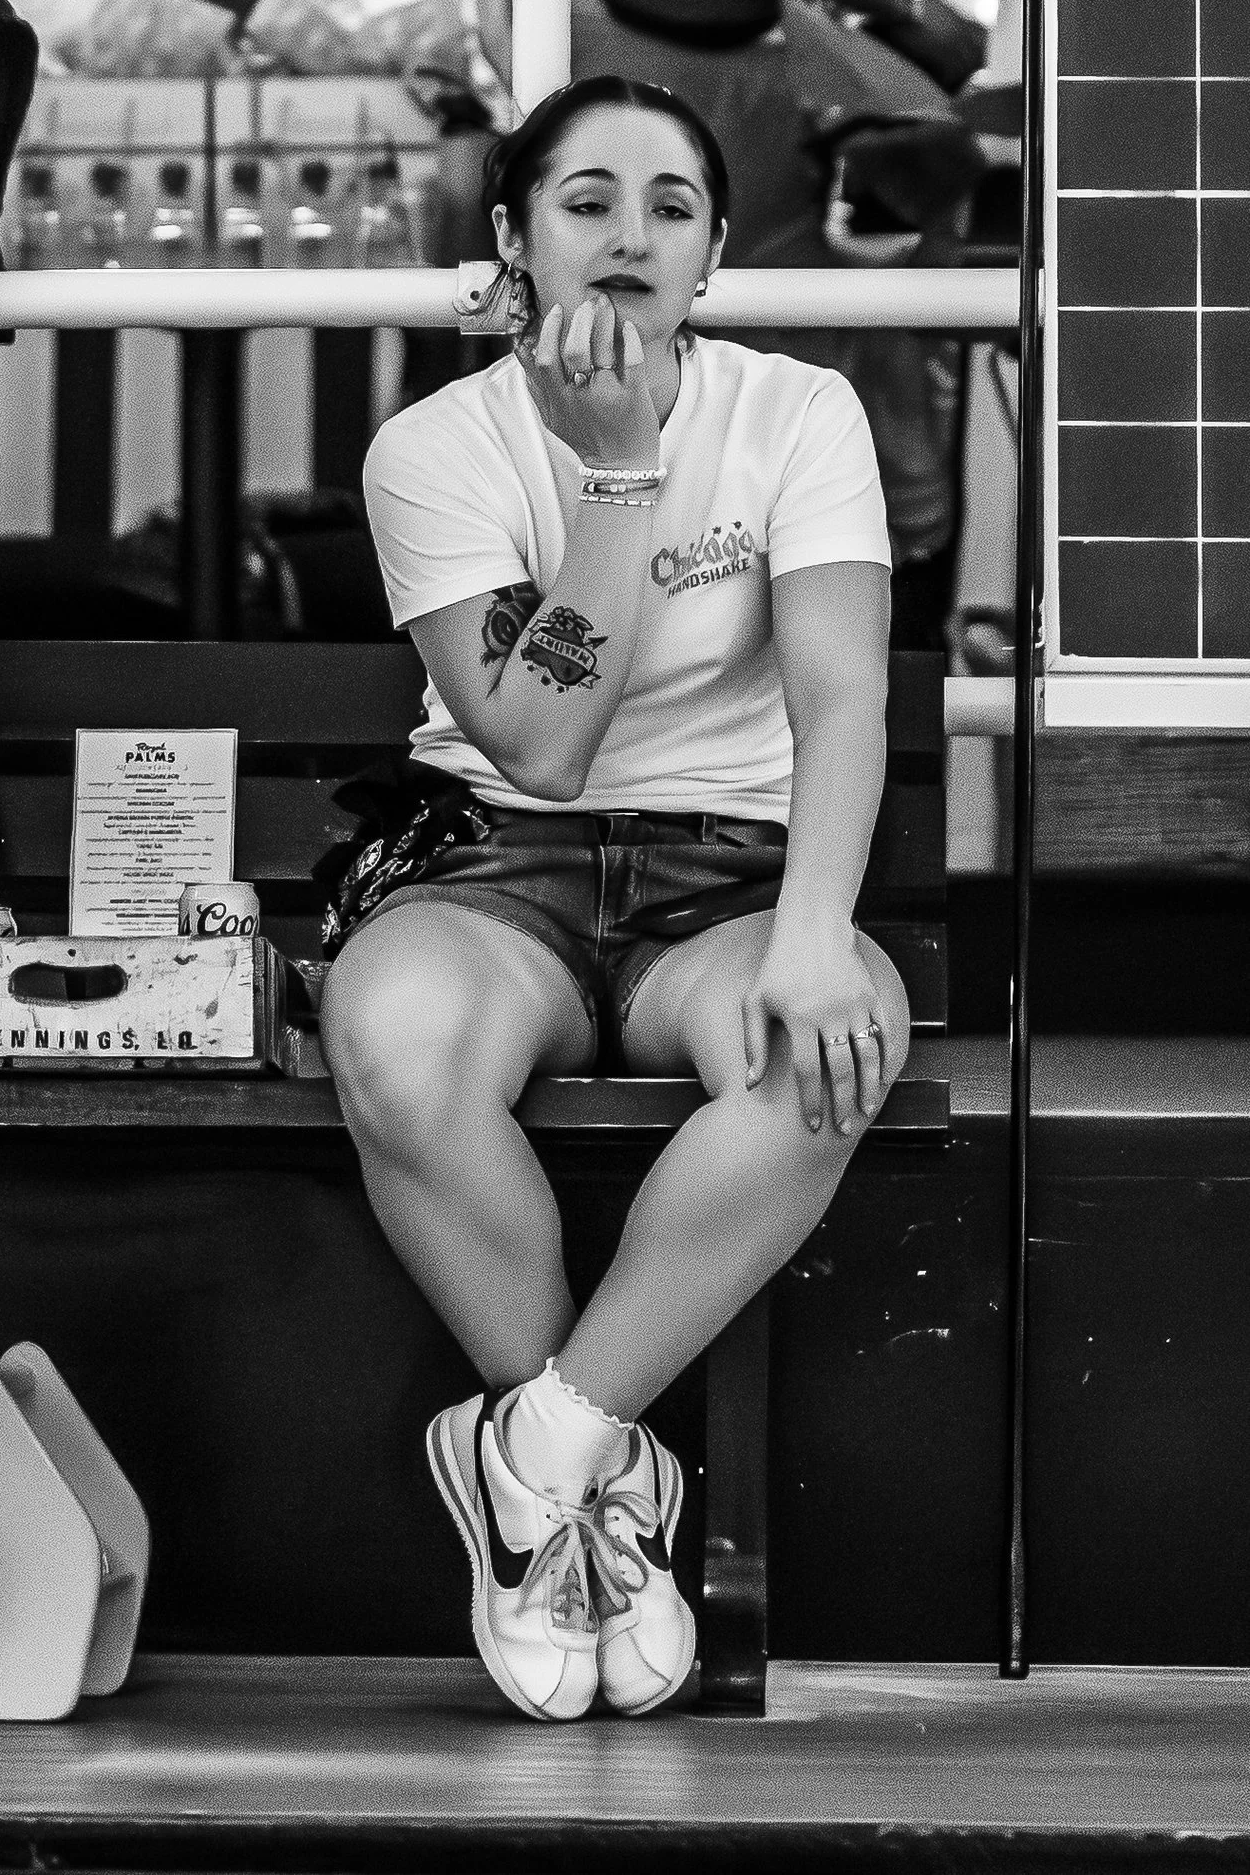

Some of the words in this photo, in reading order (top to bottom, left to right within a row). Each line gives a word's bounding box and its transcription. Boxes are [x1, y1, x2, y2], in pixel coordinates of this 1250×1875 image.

[667, 557, 750, 599] HANDSHAKE
[126, 752, 176, 763] PALMS
[136, 742, 166, 753] Royal
[196, 902, 256, 937] Coo
